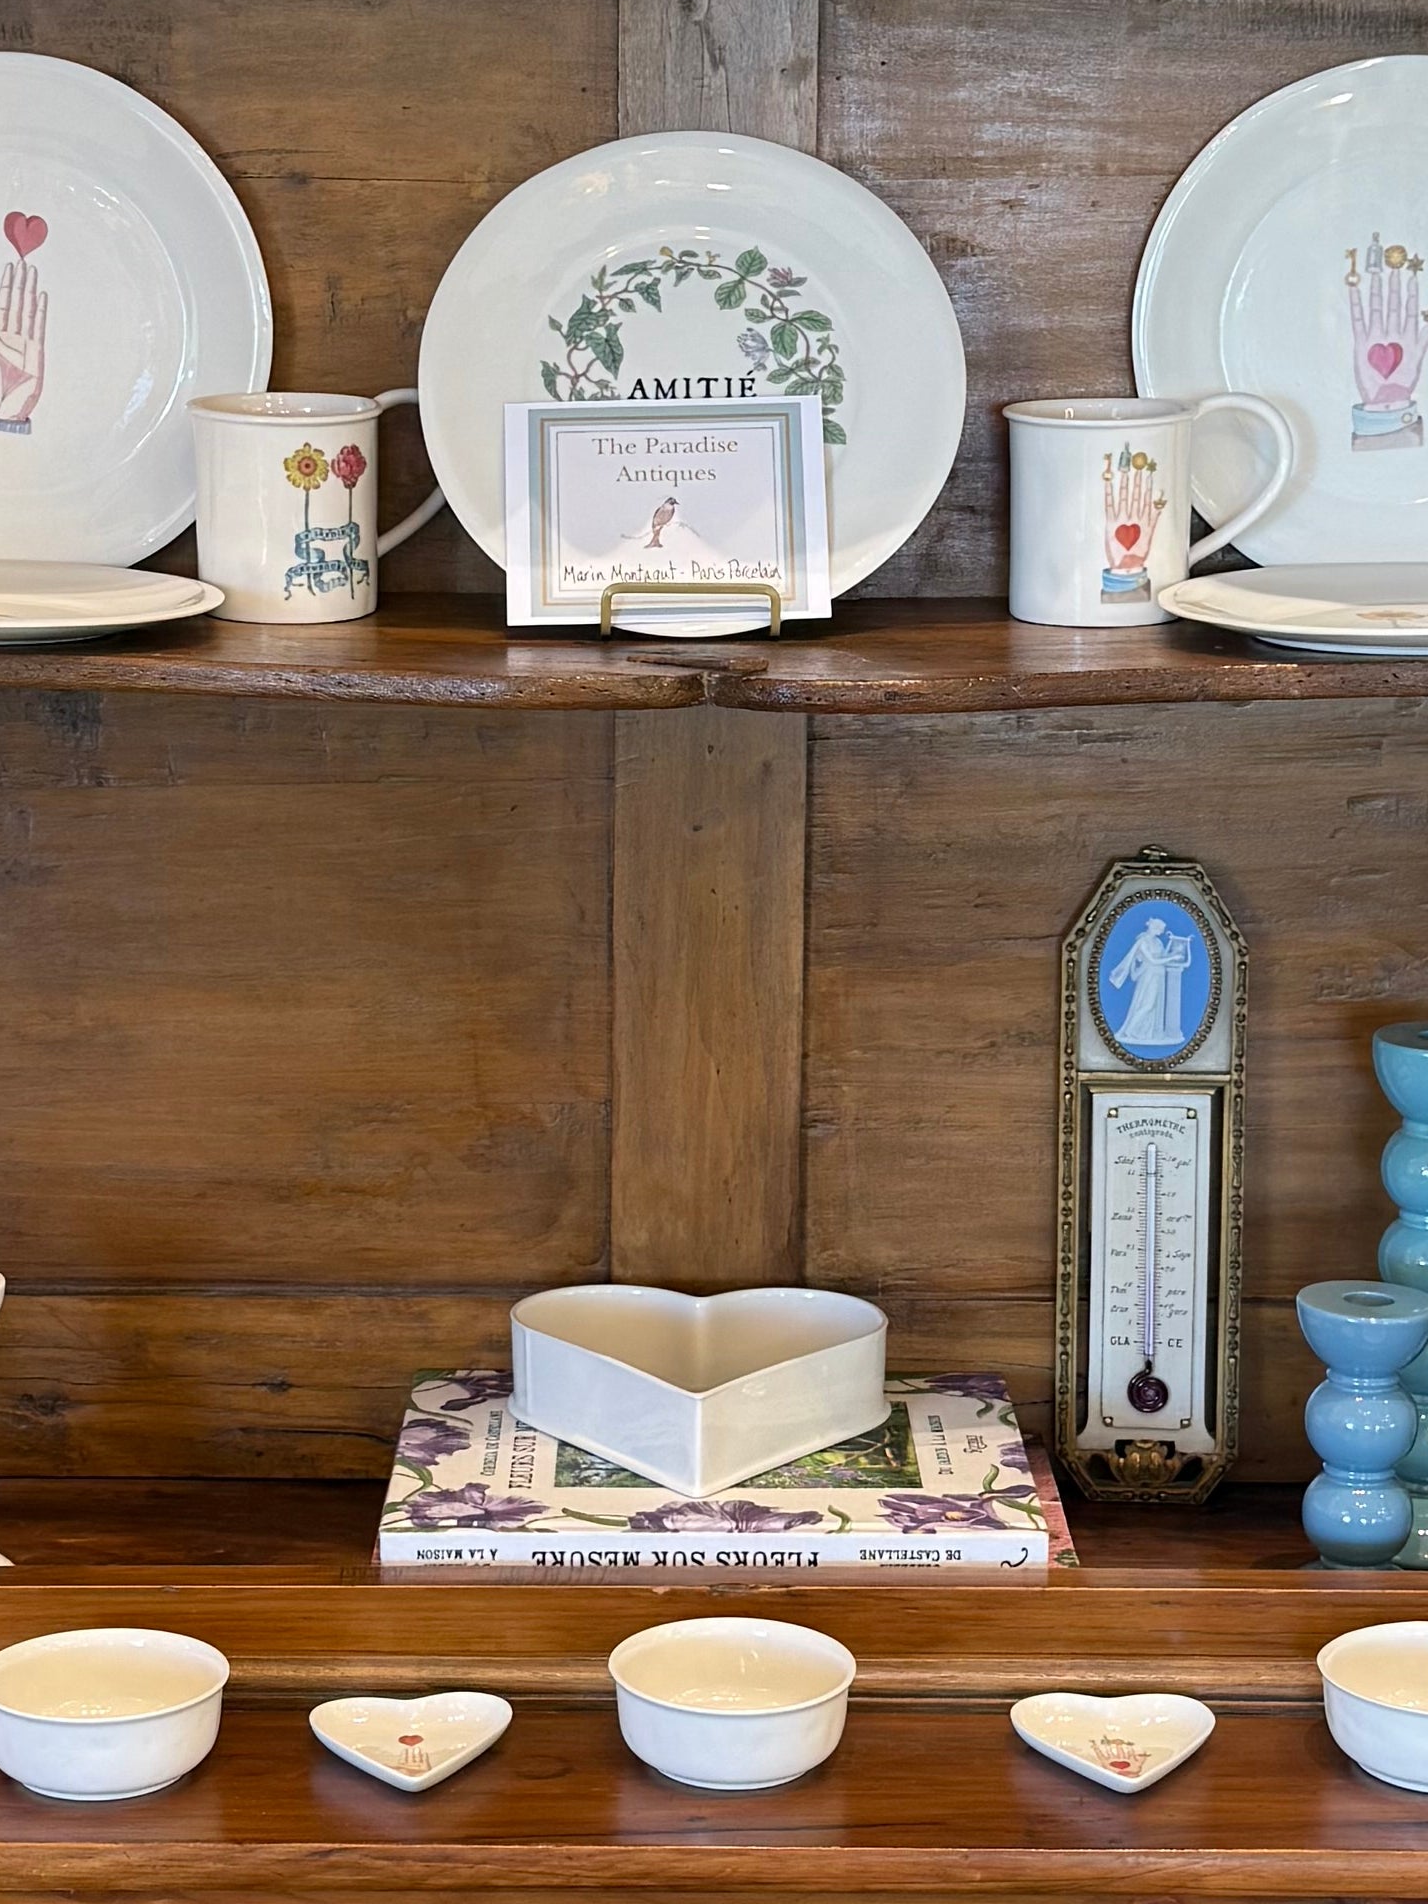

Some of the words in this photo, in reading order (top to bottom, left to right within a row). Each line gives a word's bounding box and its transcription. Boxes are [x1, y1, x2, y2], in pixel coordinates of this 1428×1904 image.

[627, 370, 759, 400] AMITIÉ
[592, 438, 637, 455] The
[645, 436, 739, 454] Paradise
[616, 465, 717, 487] Antiques
[564, 565, 605, 583] Marin
[691, 560, 725, 581] Paris
[728, 558, 782, 581] Porcelain
[1110, 1336, 1130, 1346] GLA
[1167, 1338, 1184, 1348] CE
[416, 1548, 463, 1560] MAISON
[468, 1548, 484, 1560] LA
[860, 1549, 940, 1561] CASTELLANE
[946, 1549, 961, 1560] DE
